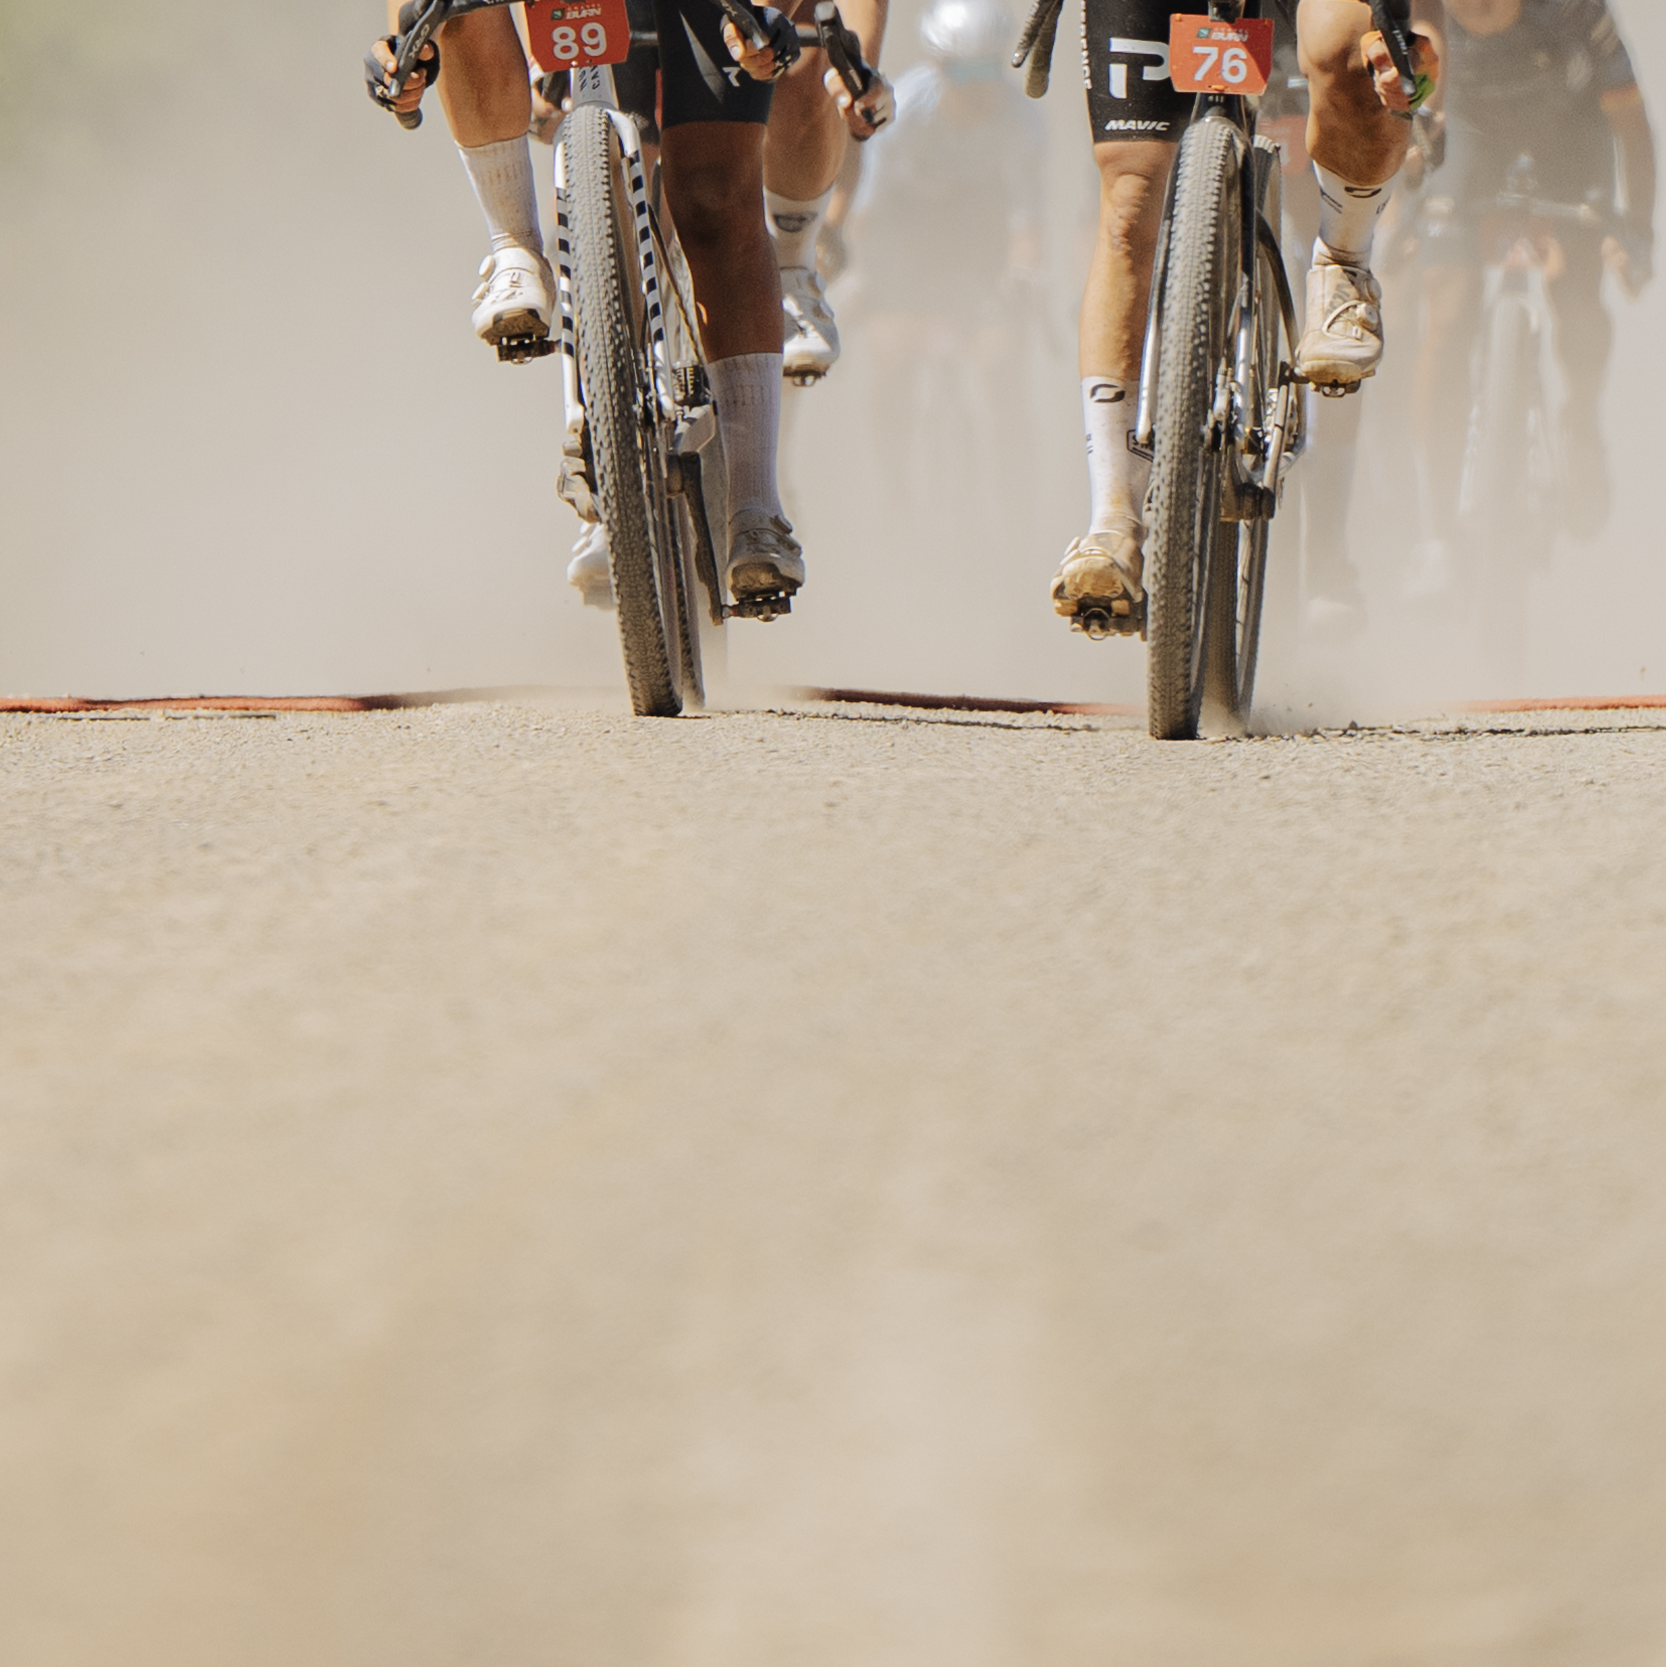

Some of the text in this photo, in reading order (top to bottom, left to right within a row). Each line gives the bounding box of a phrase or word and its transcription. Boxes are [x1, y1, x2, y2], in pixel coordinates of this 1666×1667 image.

[565, 7, 601, 19] BURN
[551, 22, 608, 61] 89
[1192, 45, 1248, 84] 76
[1105, 119, 1171, 131] MAVIC
